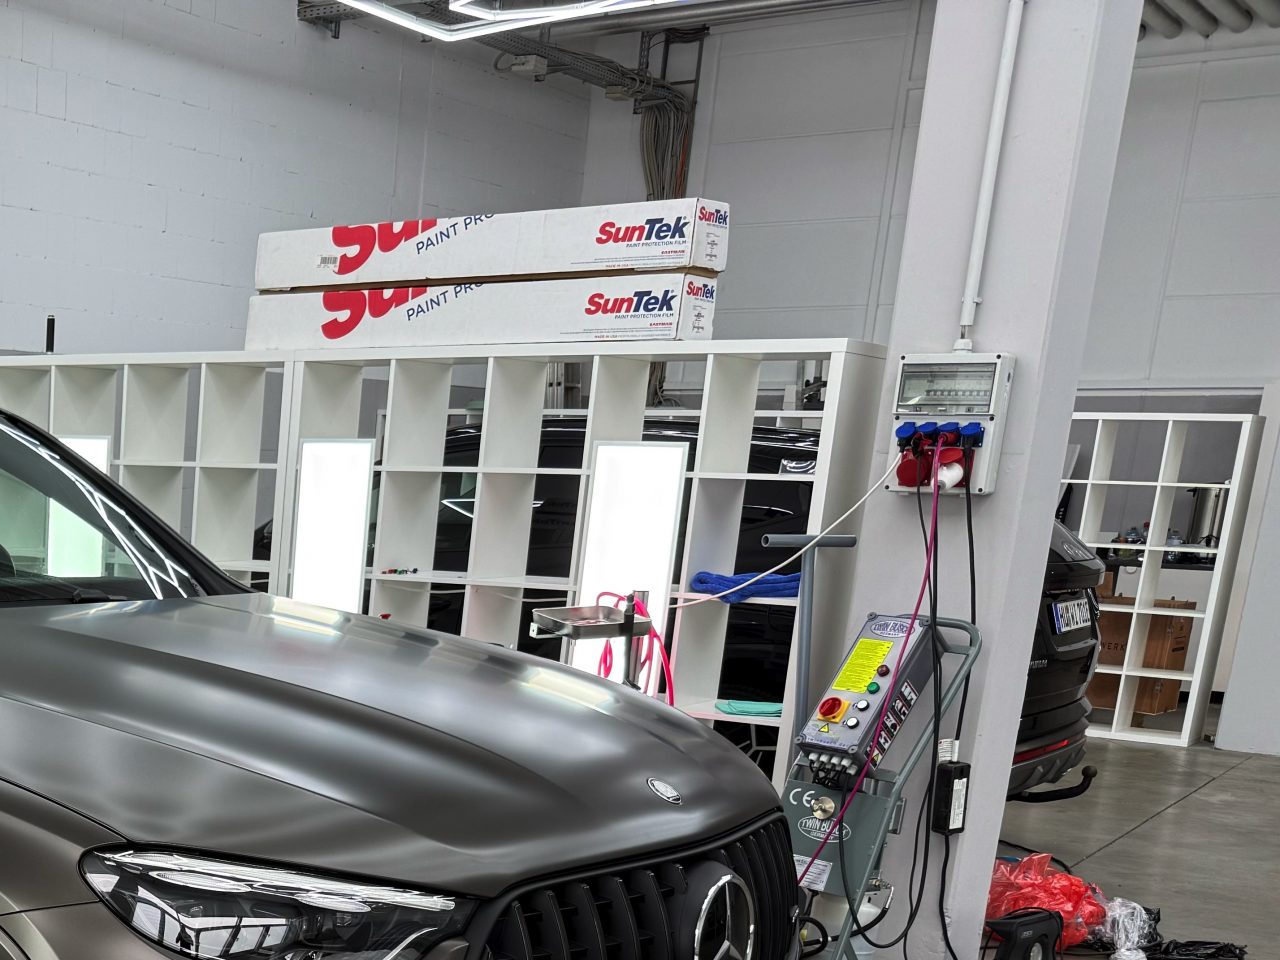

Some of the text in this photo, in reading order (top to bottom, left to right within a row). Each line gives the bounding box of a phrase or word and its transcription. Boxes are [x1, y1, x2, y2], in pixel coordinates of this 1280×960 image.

[699, 206, 729, 226] SunTek
[415, 222, 458, 255] PAINT
[595, 216, 690, 245] SunTek
[332, 219, 438, 275] Su
[642, 240, 673, 248] PROTECTION
[686, 281, 716, 300] SunTek
[321, 286, 427, 340] Su
[406, 290, 448, 321] PAINT
[584, 289, 678, 316] SunTek
[789, 788, 816, 808] CE
[801, 818, 821, 831] TWIN
[810, 831, 834, 840] GERMAY
